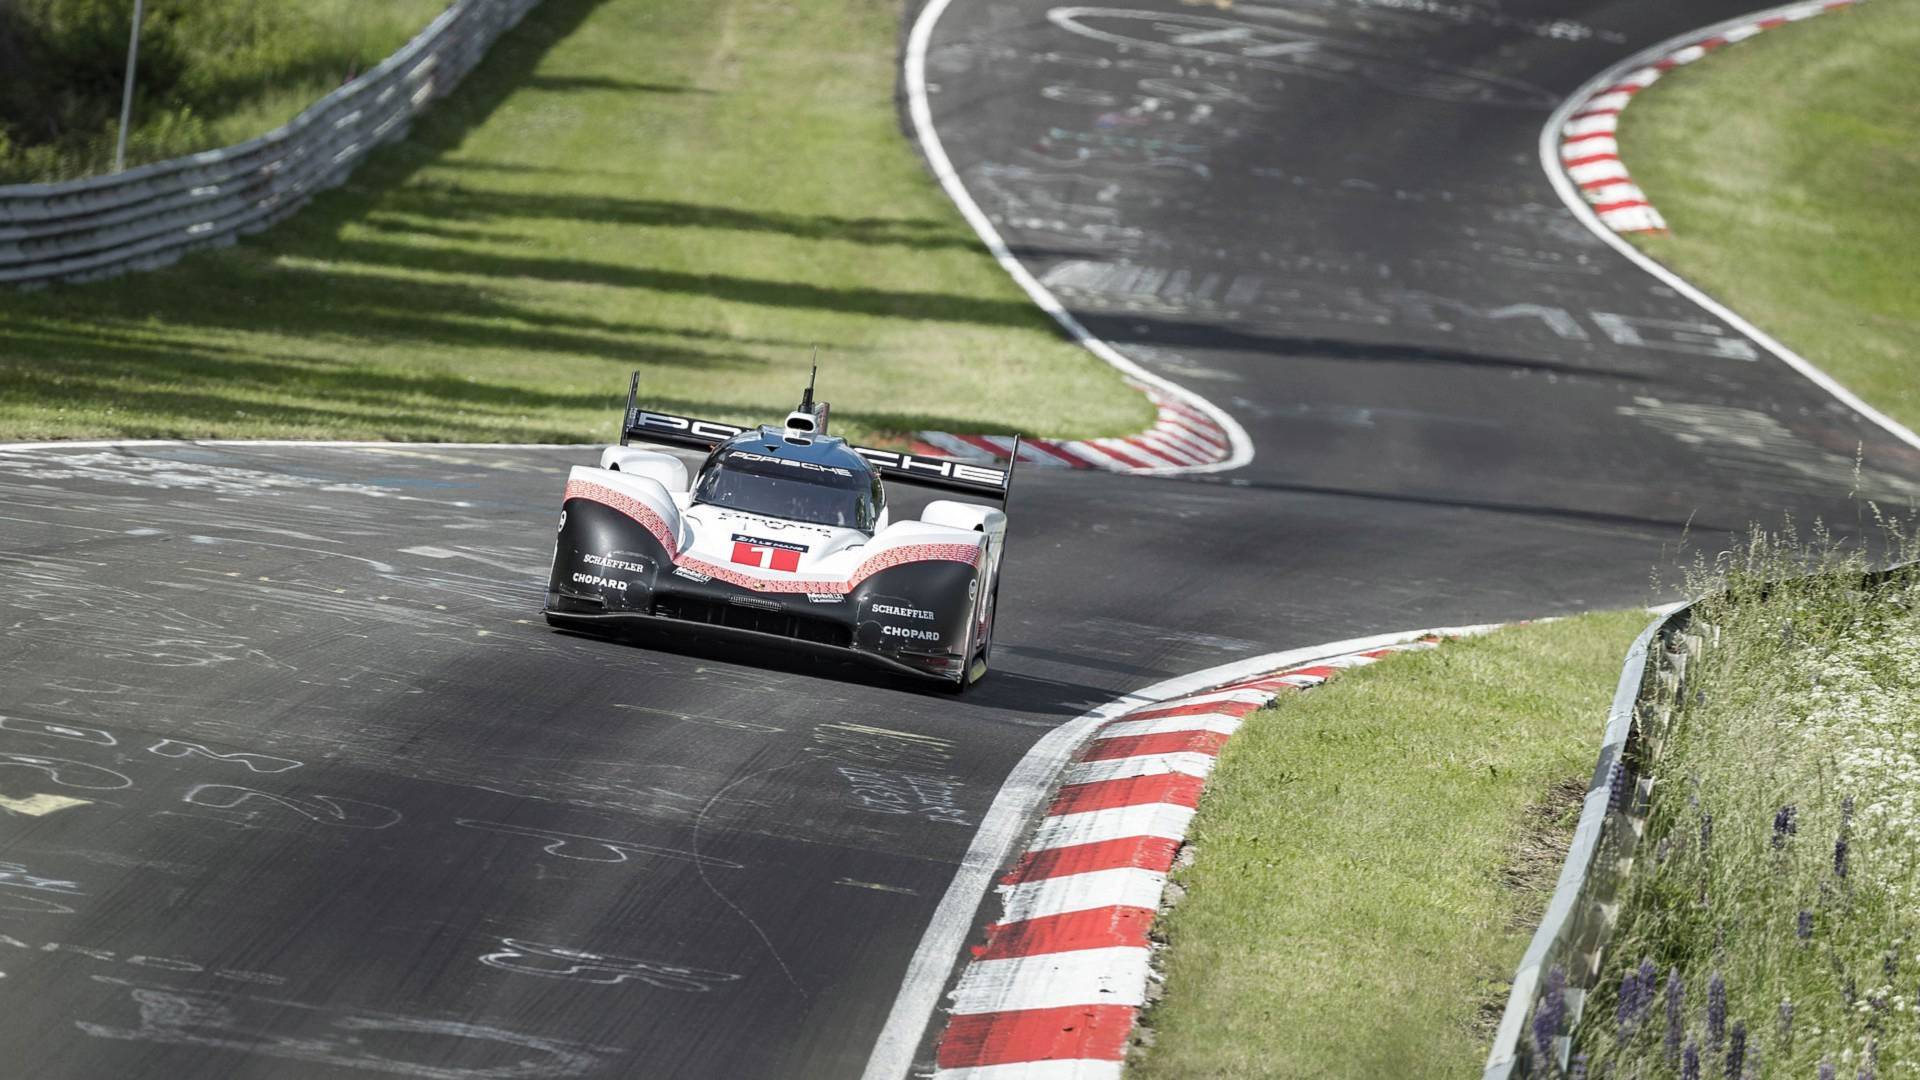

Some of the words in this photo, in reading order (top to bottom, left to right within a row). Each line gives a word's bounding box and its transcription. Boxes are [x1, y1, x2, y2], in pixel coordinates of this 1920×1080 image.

[638, 412, 1005, 485] POCHE
[729, 451, 853, 477] PORSCHE
[583, 554, 644, 573] SCHAEFFLER
[751, 547, 774, 569] 1
[572, 572, 628, 591] CHOPARD
[872, 603, 935, 620] SCHAEFFLER
[883, 625, 940, 641] CHOPARD
